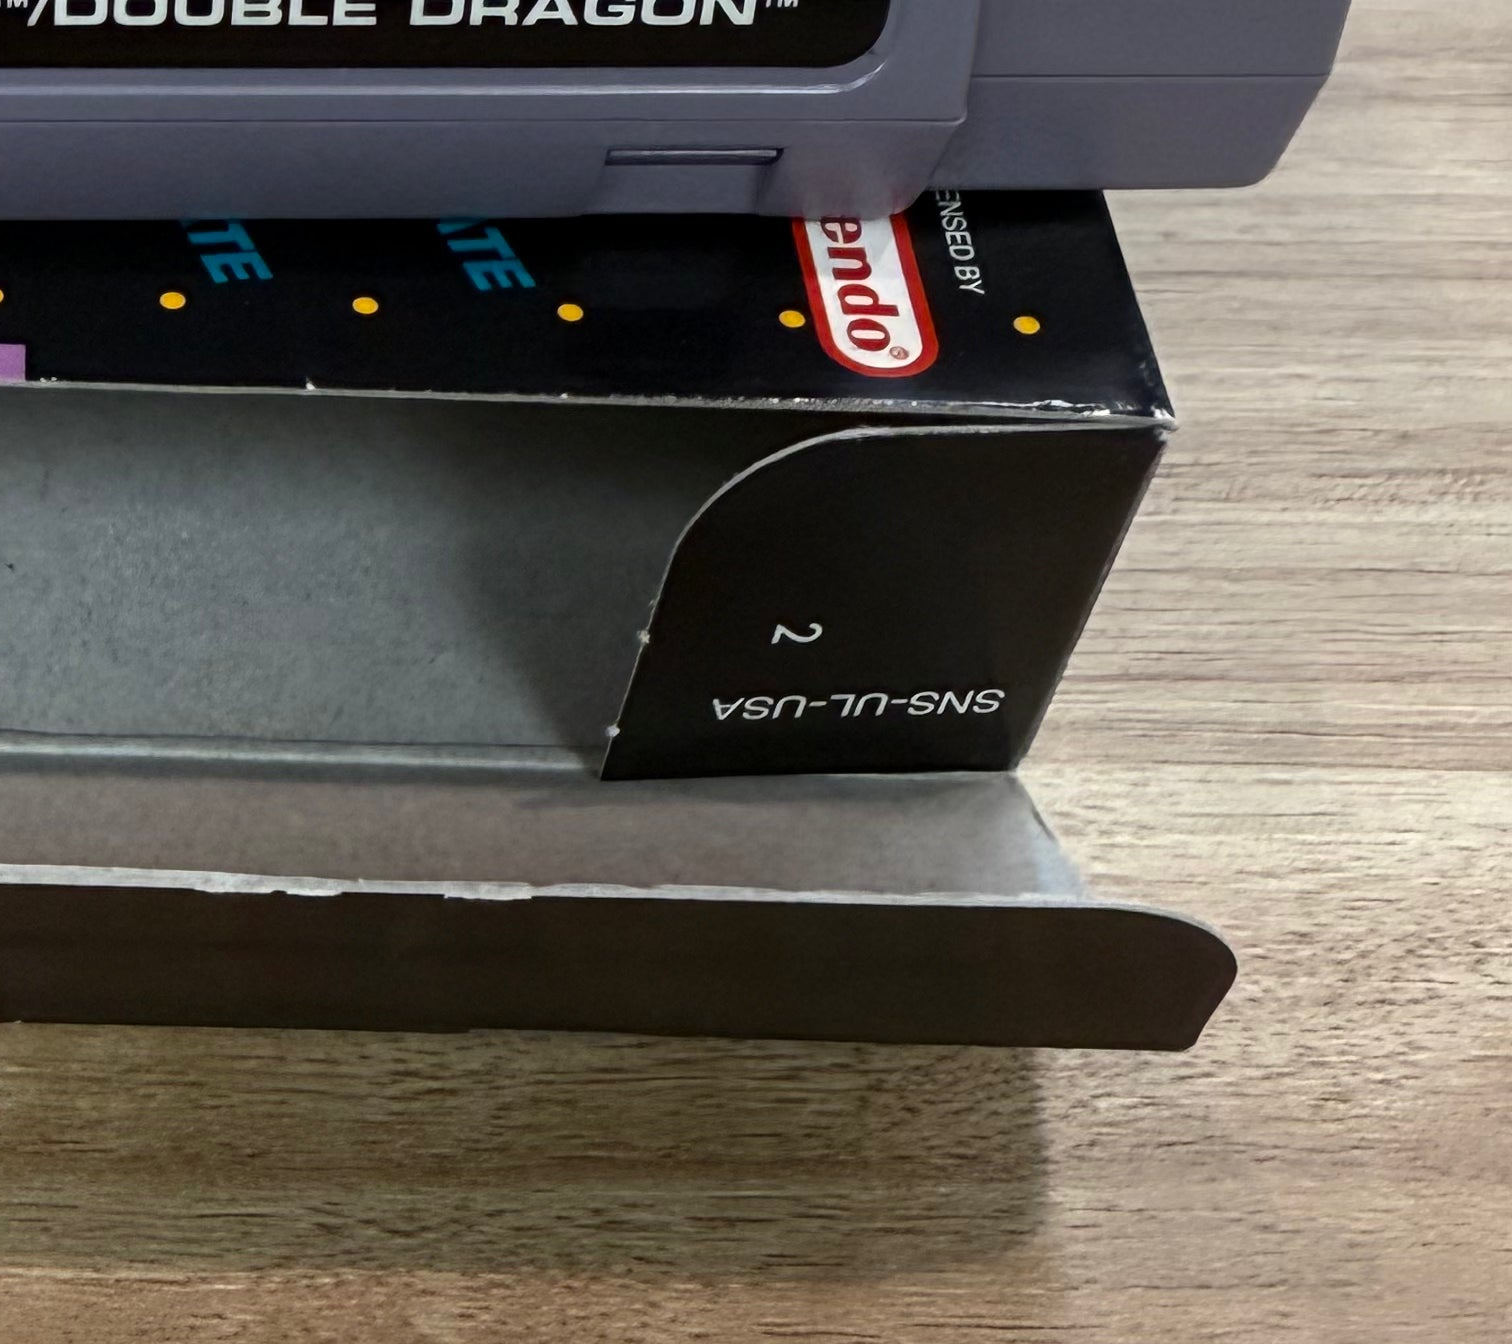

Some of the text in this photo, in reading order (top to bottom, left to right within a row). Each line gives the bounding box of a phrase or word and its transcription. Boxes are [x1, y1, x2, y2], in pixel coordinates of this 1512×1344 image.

[953, 264, 986, 296] BY
[770, 622, 824, 646] 2
[711, 688, 1006, 720] SNS-UL-USA
